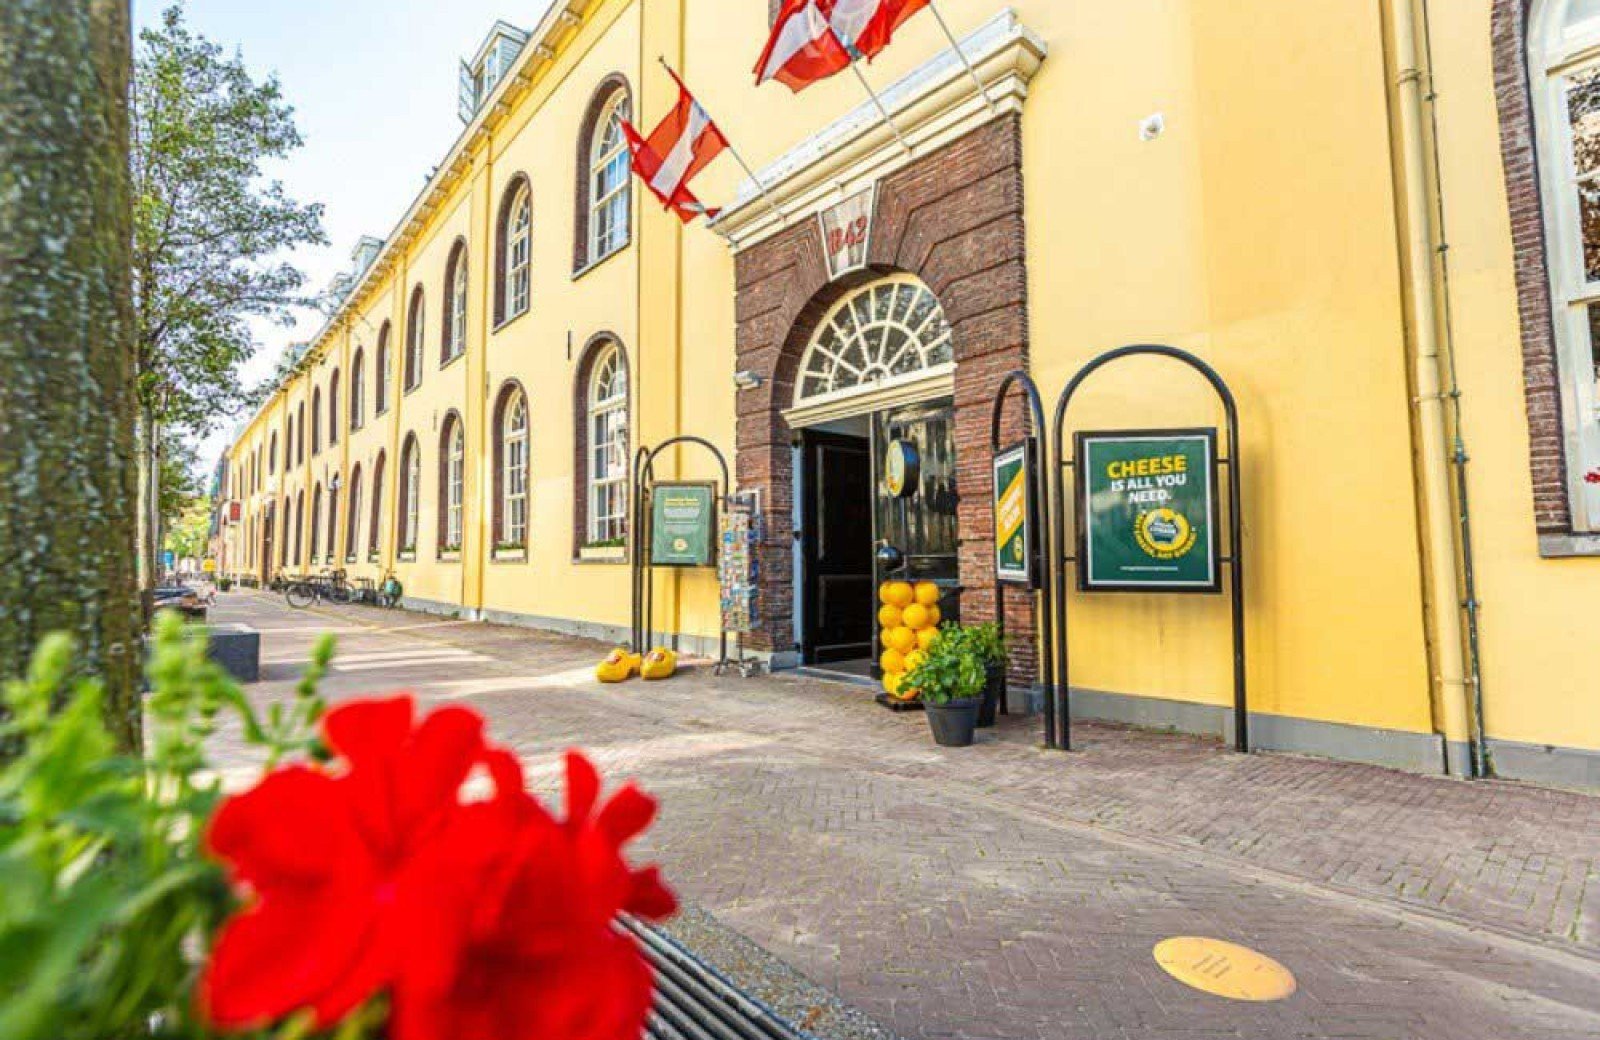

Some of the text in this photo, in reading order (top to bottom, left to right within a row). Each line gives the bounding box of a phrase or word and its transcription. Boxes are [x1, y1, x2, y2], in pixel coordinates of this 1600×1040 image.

[1107, 455, 1187, 478] CHEESE
[1111, 474, 1187, 492] IS ALL YOU
[1128, 489, 1172, 503] NEED.
